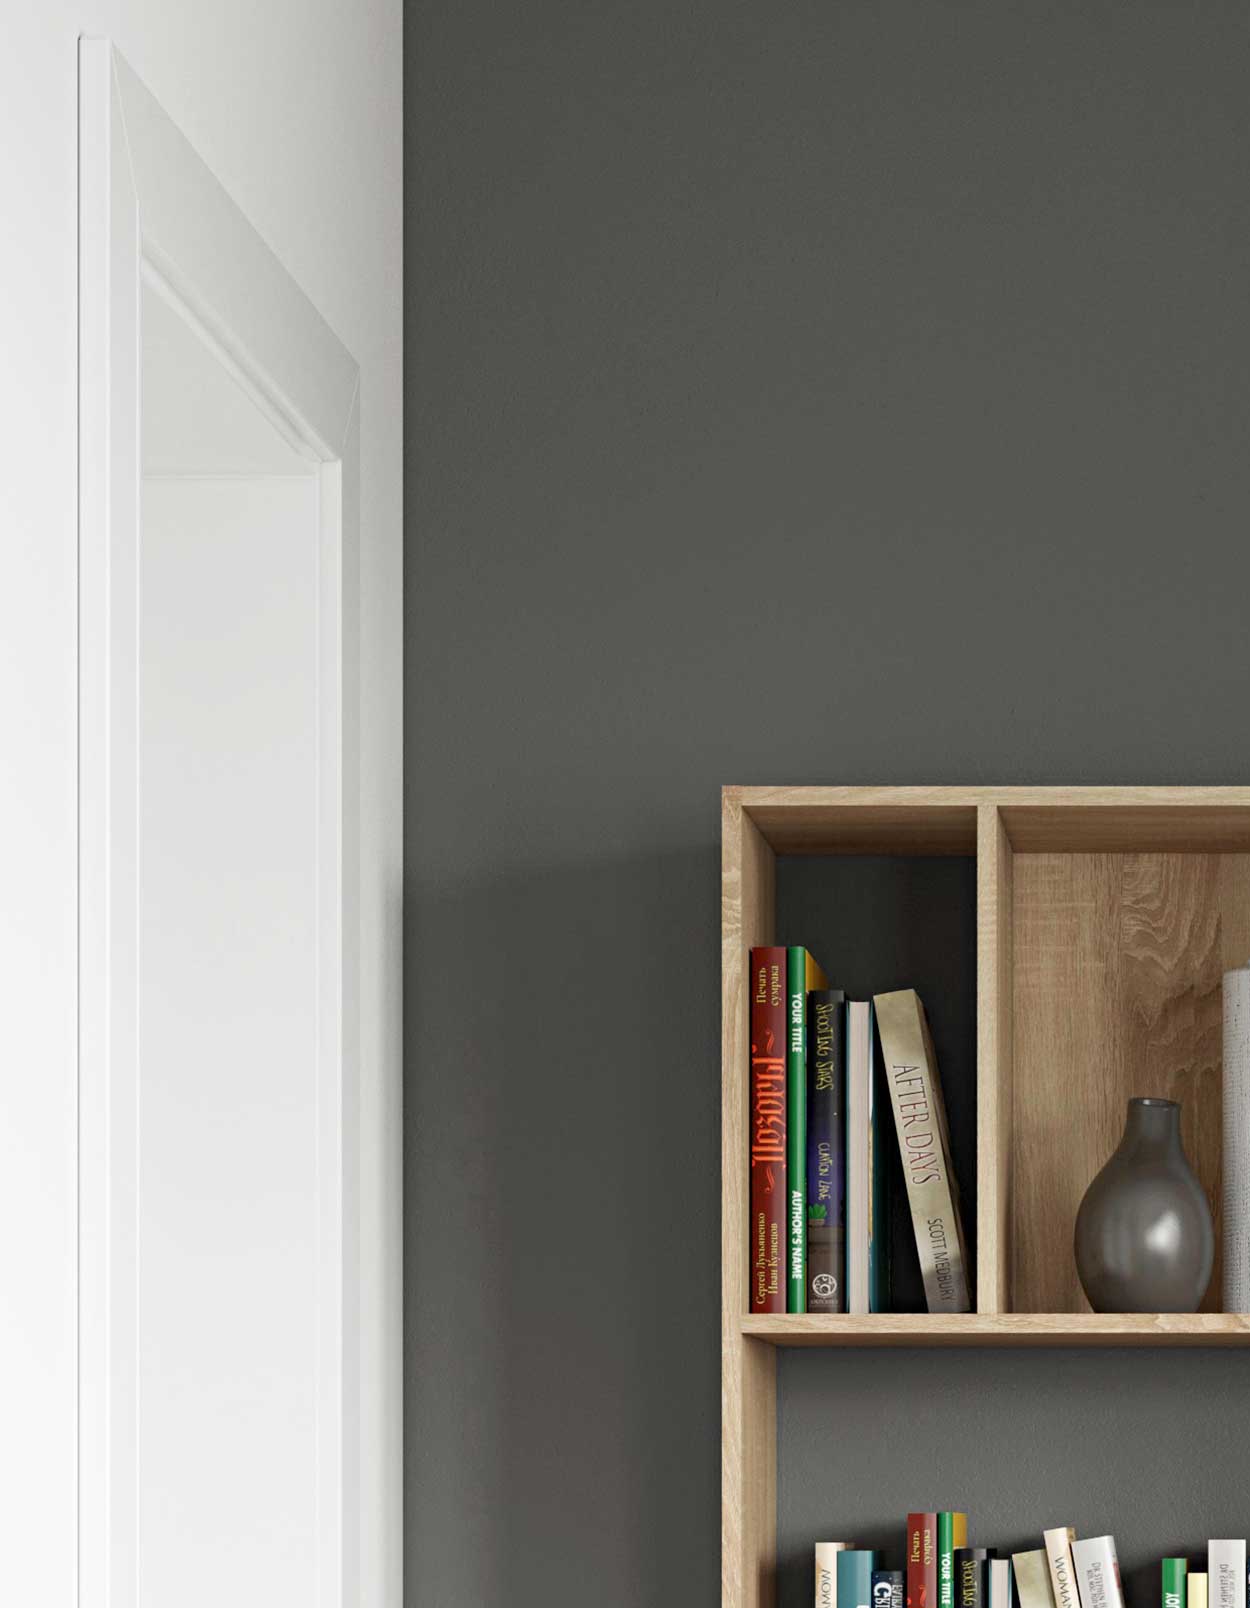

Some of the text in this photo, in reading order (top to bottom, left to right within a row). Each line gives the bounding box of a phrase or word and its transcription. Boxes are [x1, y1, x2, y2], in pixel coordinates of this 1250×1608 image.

[757, 967, 766, 1003] Печать
[770, 965, 779, 1006] сумрака
[792, 993, 802, 1053] YOUR TITLE
[816, 1004, 833, 1090] SHOOTING STARS
[893, 1065, 941, 1185] AFTER DAYS
[817, 1143, 832, 1201] CLAYTON LANE
[767, 1224, 779, 1294] Иван Кузнецов
[791, 1191, 802, 1279] AUTHOR'S NAME
[927, 1219, 956, 1301] SCOTT MEDBURY
[755, 1270, 766, 1304] Сергей
[942, 1552, 950, 1603] YOUR TITLE
